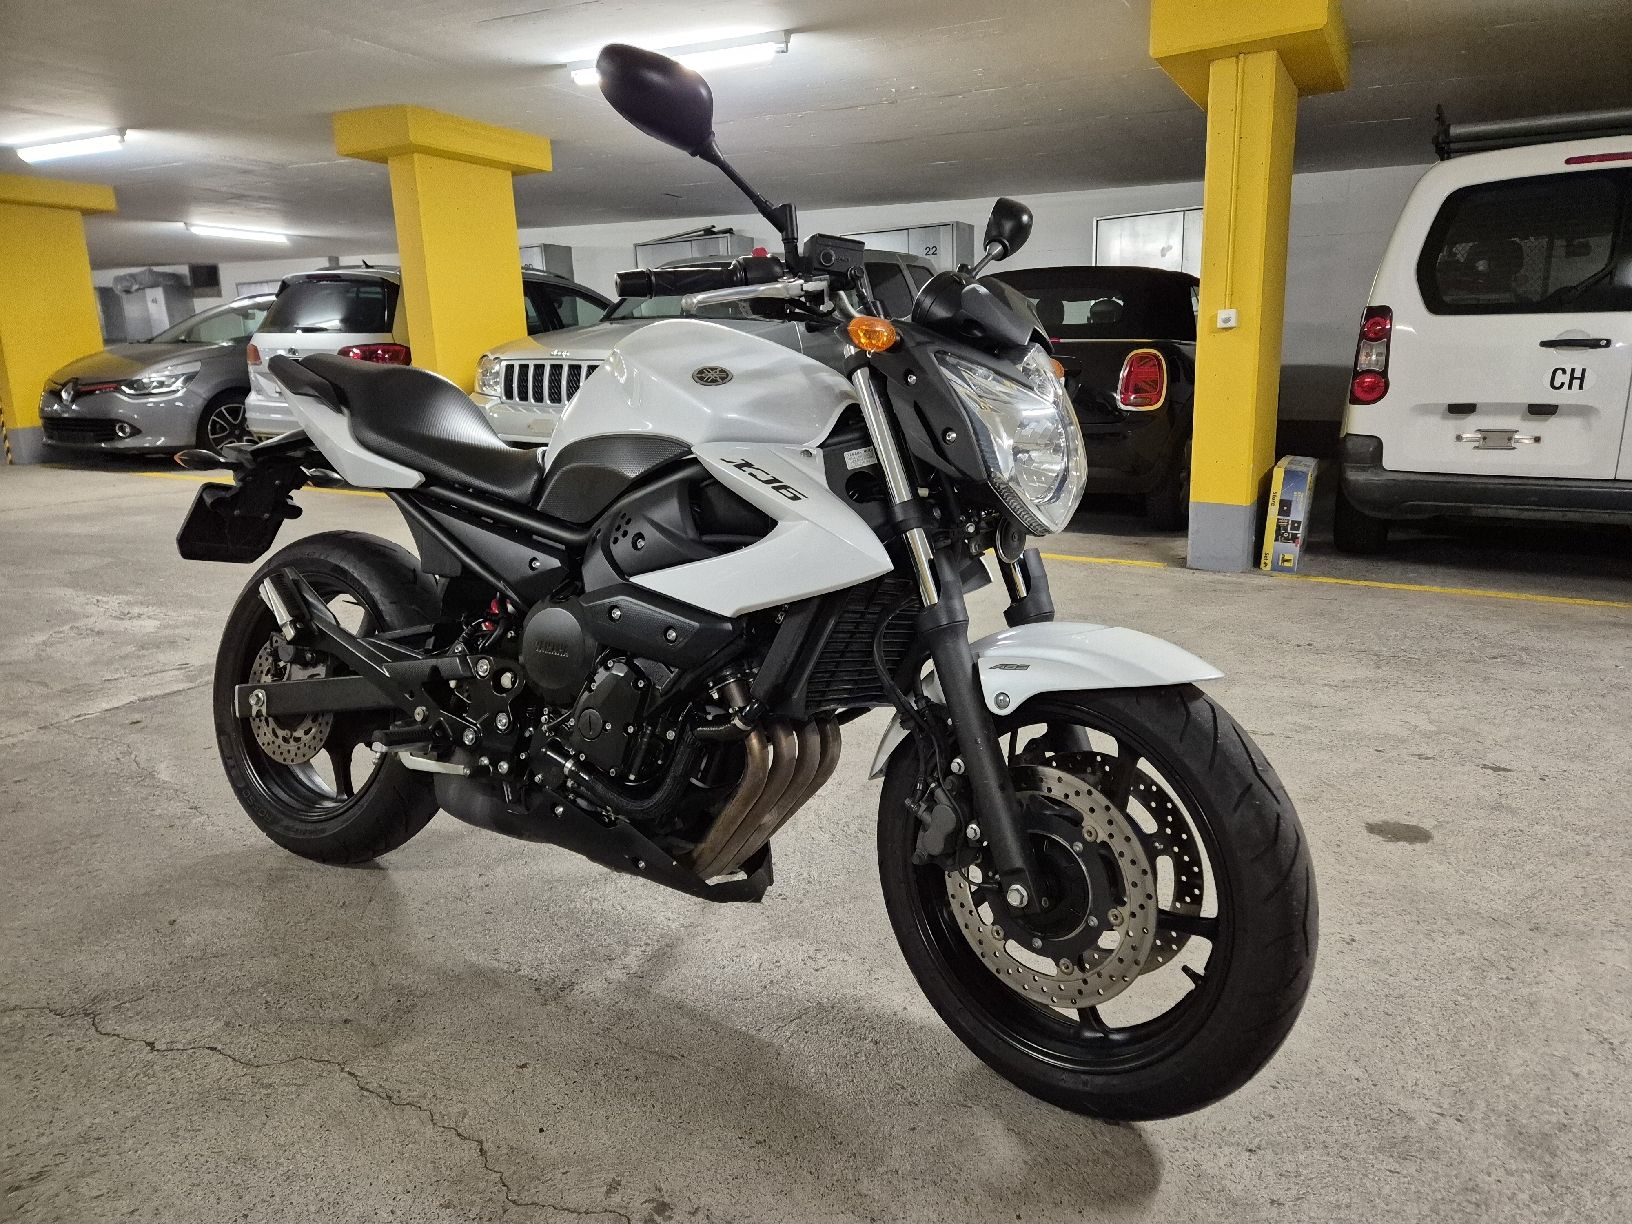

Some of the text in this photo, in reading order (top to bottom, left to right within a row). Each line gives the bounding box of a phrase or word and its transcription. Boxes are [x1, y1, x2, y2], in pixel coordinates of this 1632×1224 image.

[924, 245, 938, 256] 22
[1549, 367, 1587, 391] CH
[720, 458, 809, 502] XJ6
